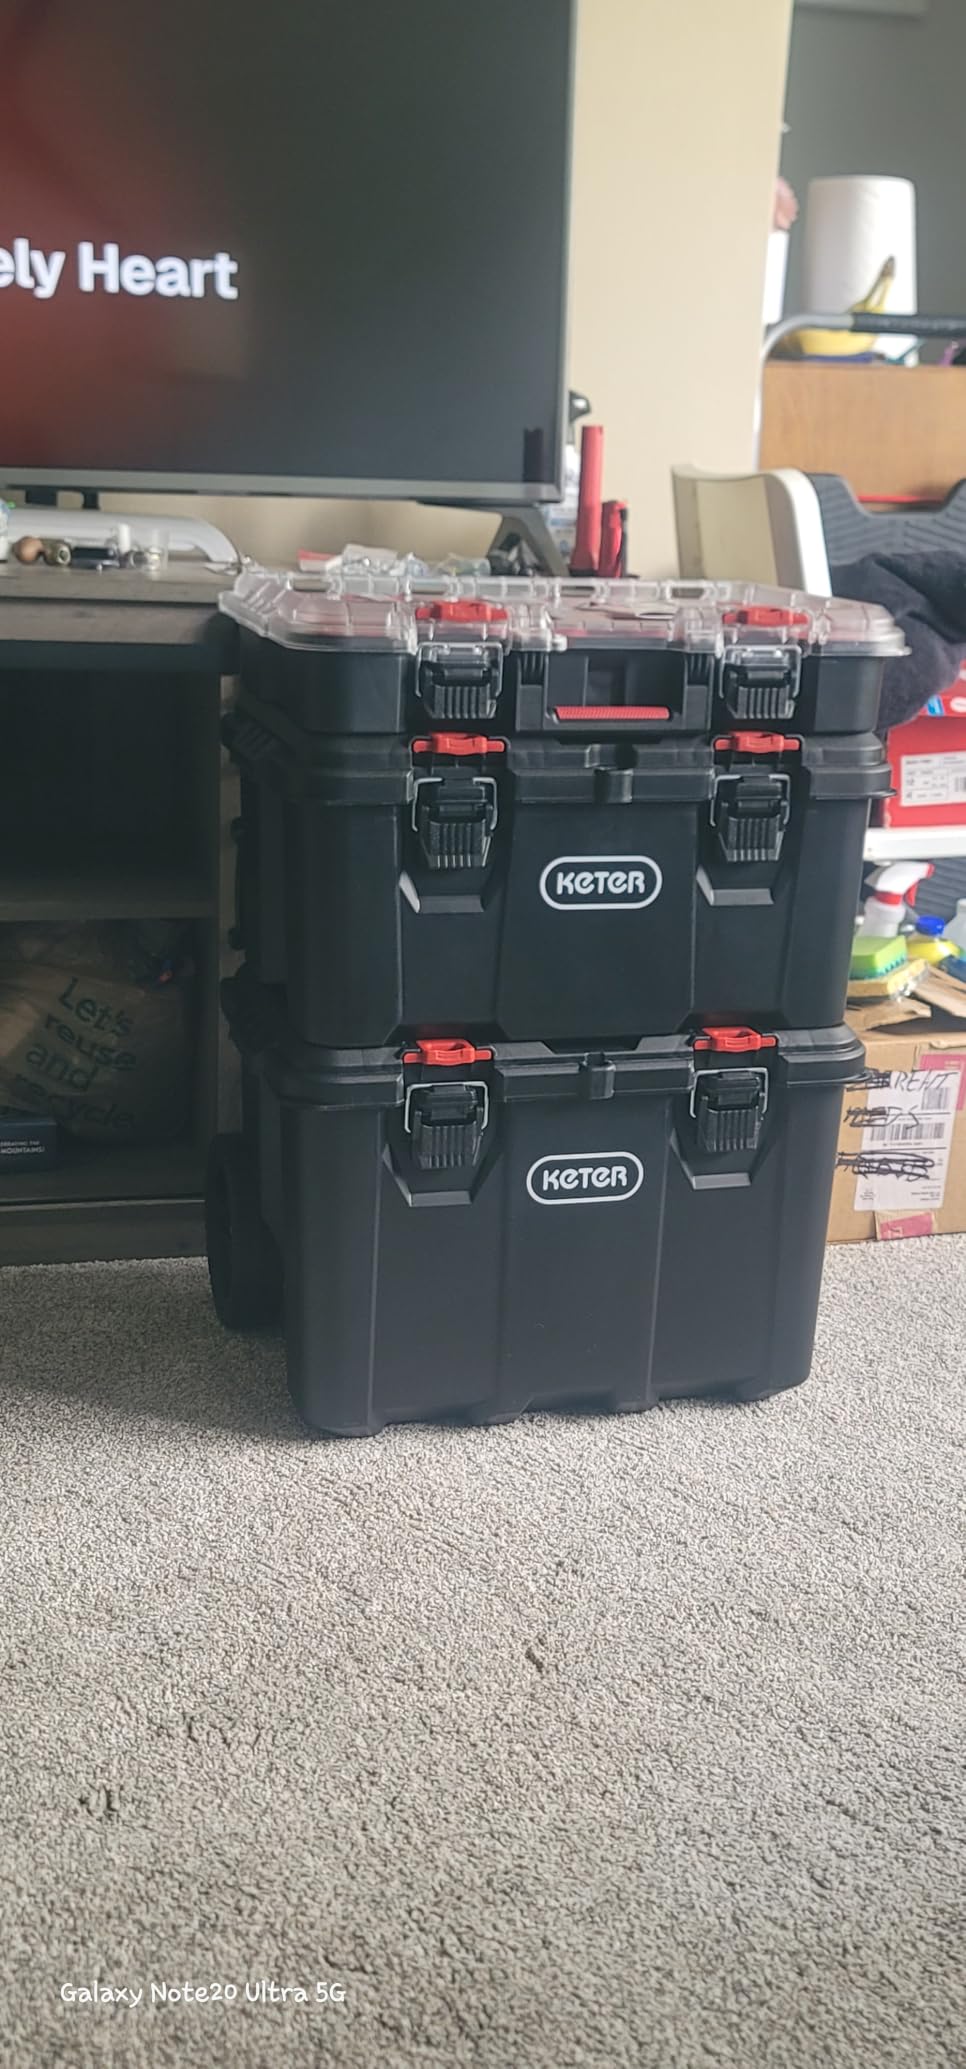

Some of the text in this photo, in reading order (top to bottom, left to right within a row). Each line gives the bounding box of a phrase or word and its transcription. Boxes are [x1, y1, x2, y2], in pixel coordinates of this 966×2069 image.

[78, 241, 238, 299] Heart
[26, 1043, 99, 1092] and
[45, 1013, 136, 1071] reuse
